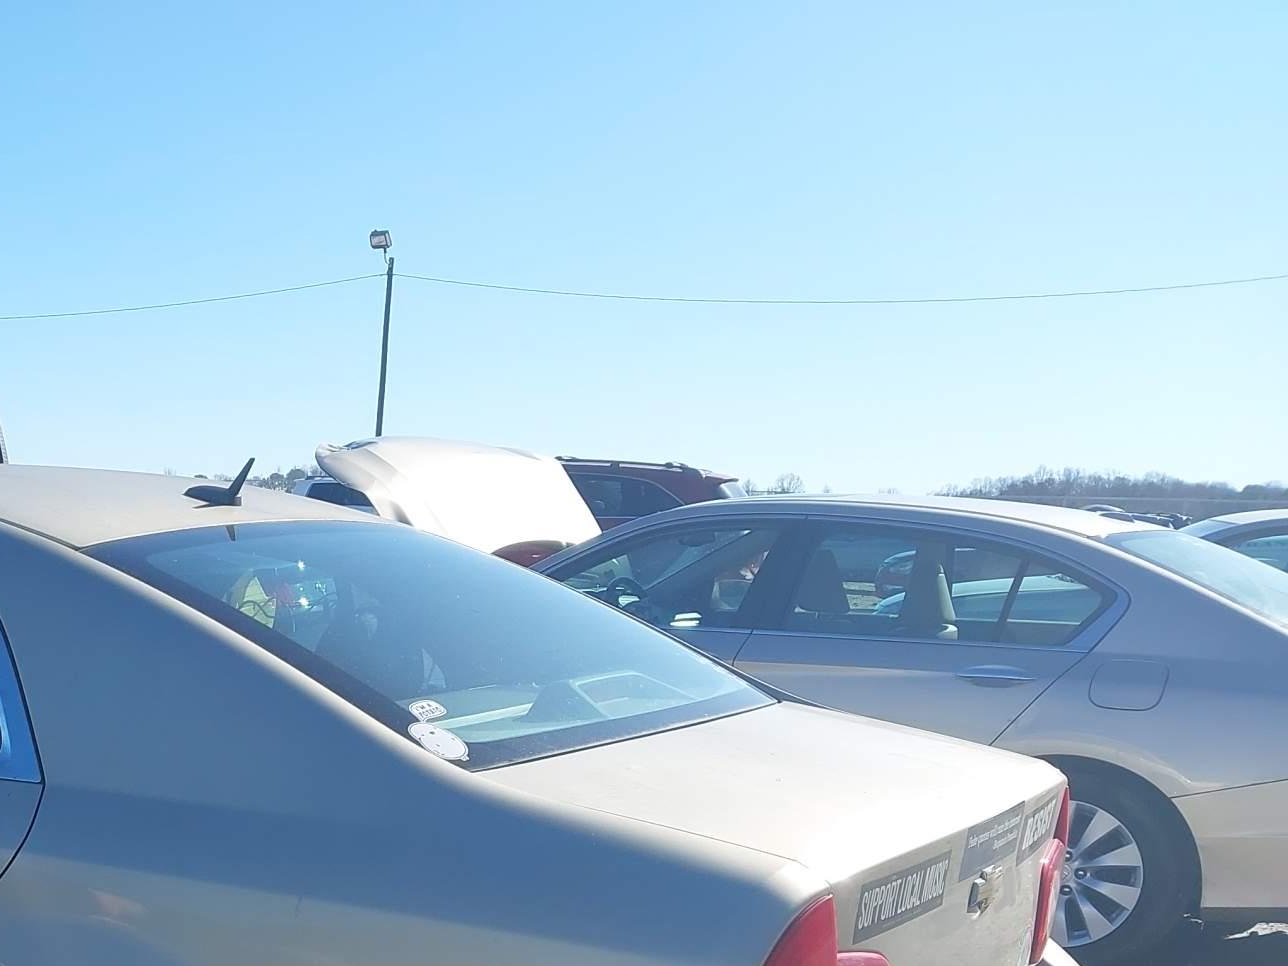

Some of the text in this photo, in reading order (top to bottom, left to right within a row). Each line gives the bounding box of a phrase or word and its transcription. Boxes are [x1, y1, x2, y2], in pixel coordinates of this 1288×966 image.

[1022, 798, 1057, 850] RESIST
[858, 859, 949, 930] SUPPORT LOCAL MUSIC
